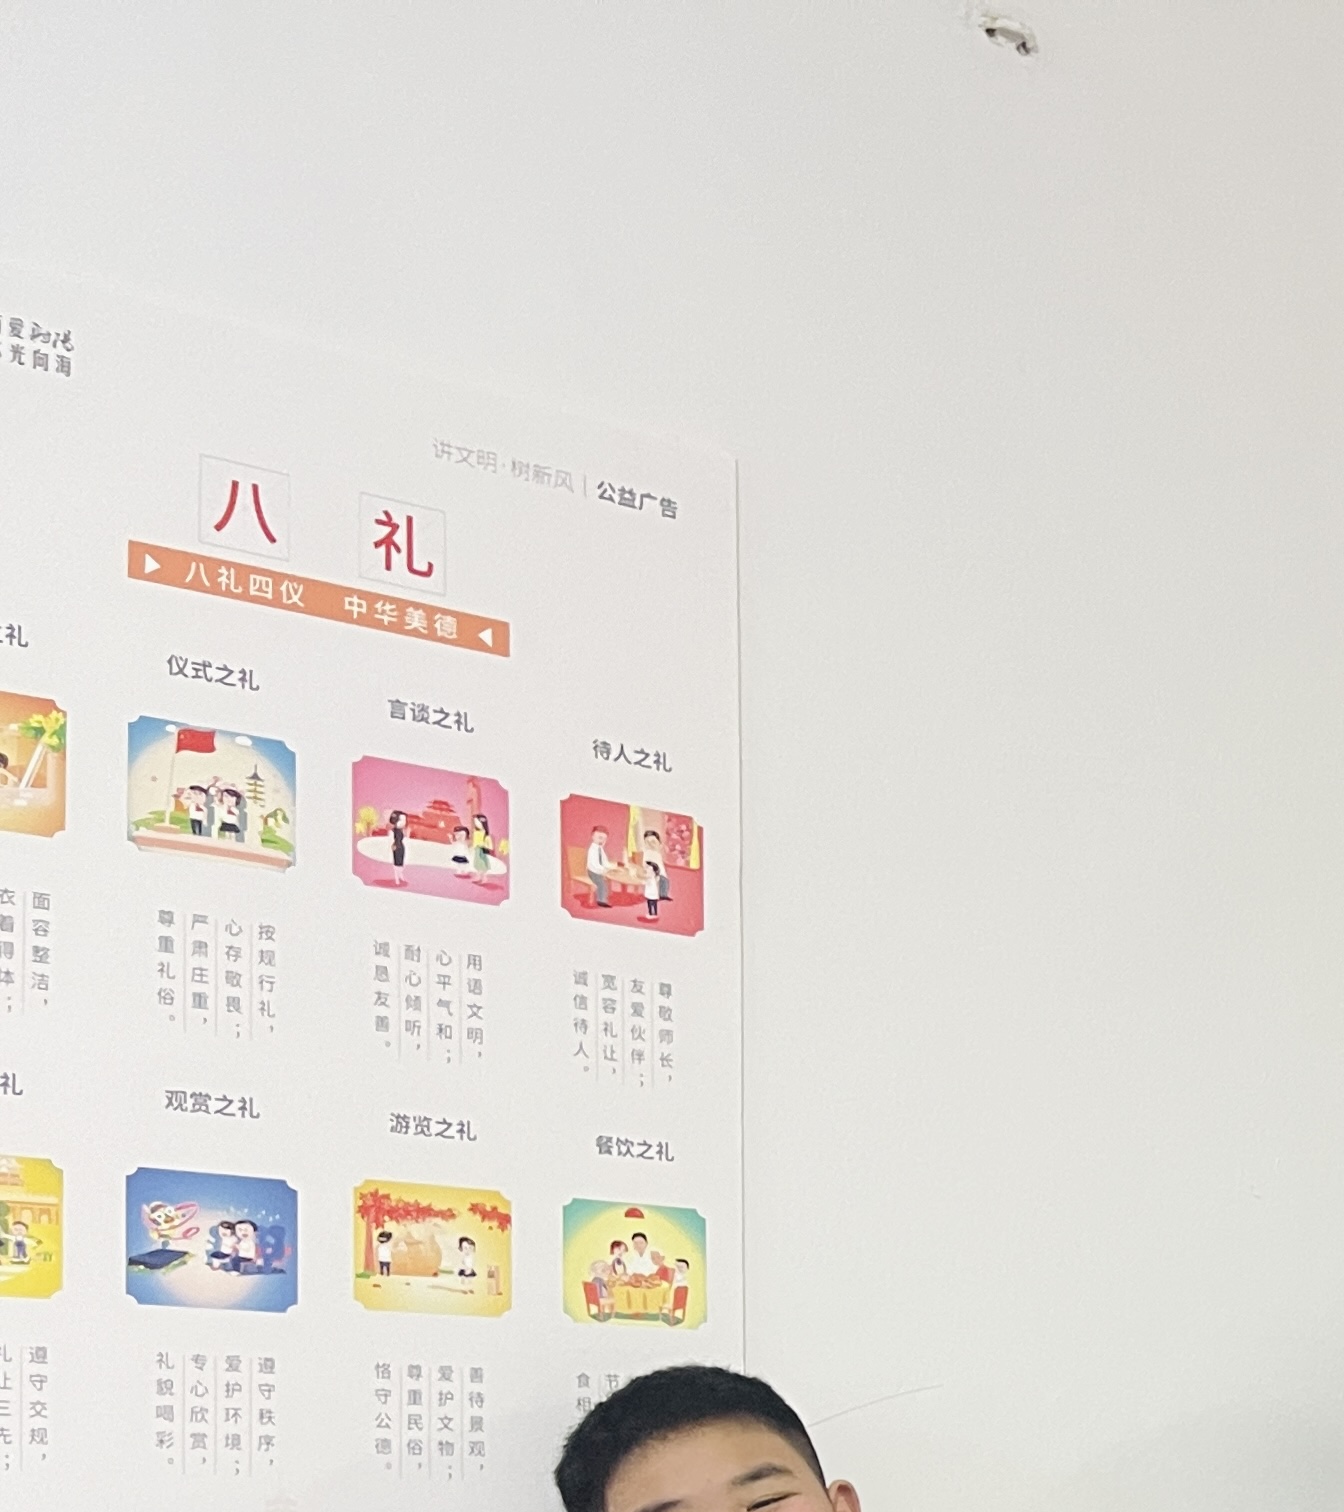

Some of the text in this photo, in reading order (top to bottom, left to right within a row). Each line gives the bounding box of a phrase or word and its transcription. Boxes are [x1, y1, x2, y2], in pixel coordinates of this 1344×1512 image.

[0, 314, 74, 351] 爱射阳
[0, 341, 71, 377] 光向海
[214, 480, 277, 544] 八
[597, 480, 679, 520] 公益广告
[373, 510, 434, 578] 礼
[185, 562, 459, 640] 八礼四仪 中华美德
[0, 622, 29, 648] 礼
[166, 654, 260, 691] 仪式之礼
[387, 698, 475, 733] 言谈之礼
[592, 738, 673, 773] 待人之礼
[164, 1090, 261, 1119] 观赏之礼
[390, 1112, 478, 1142] 游览之礼
[595, 1134, 675, 1164] 餐饮之礼
